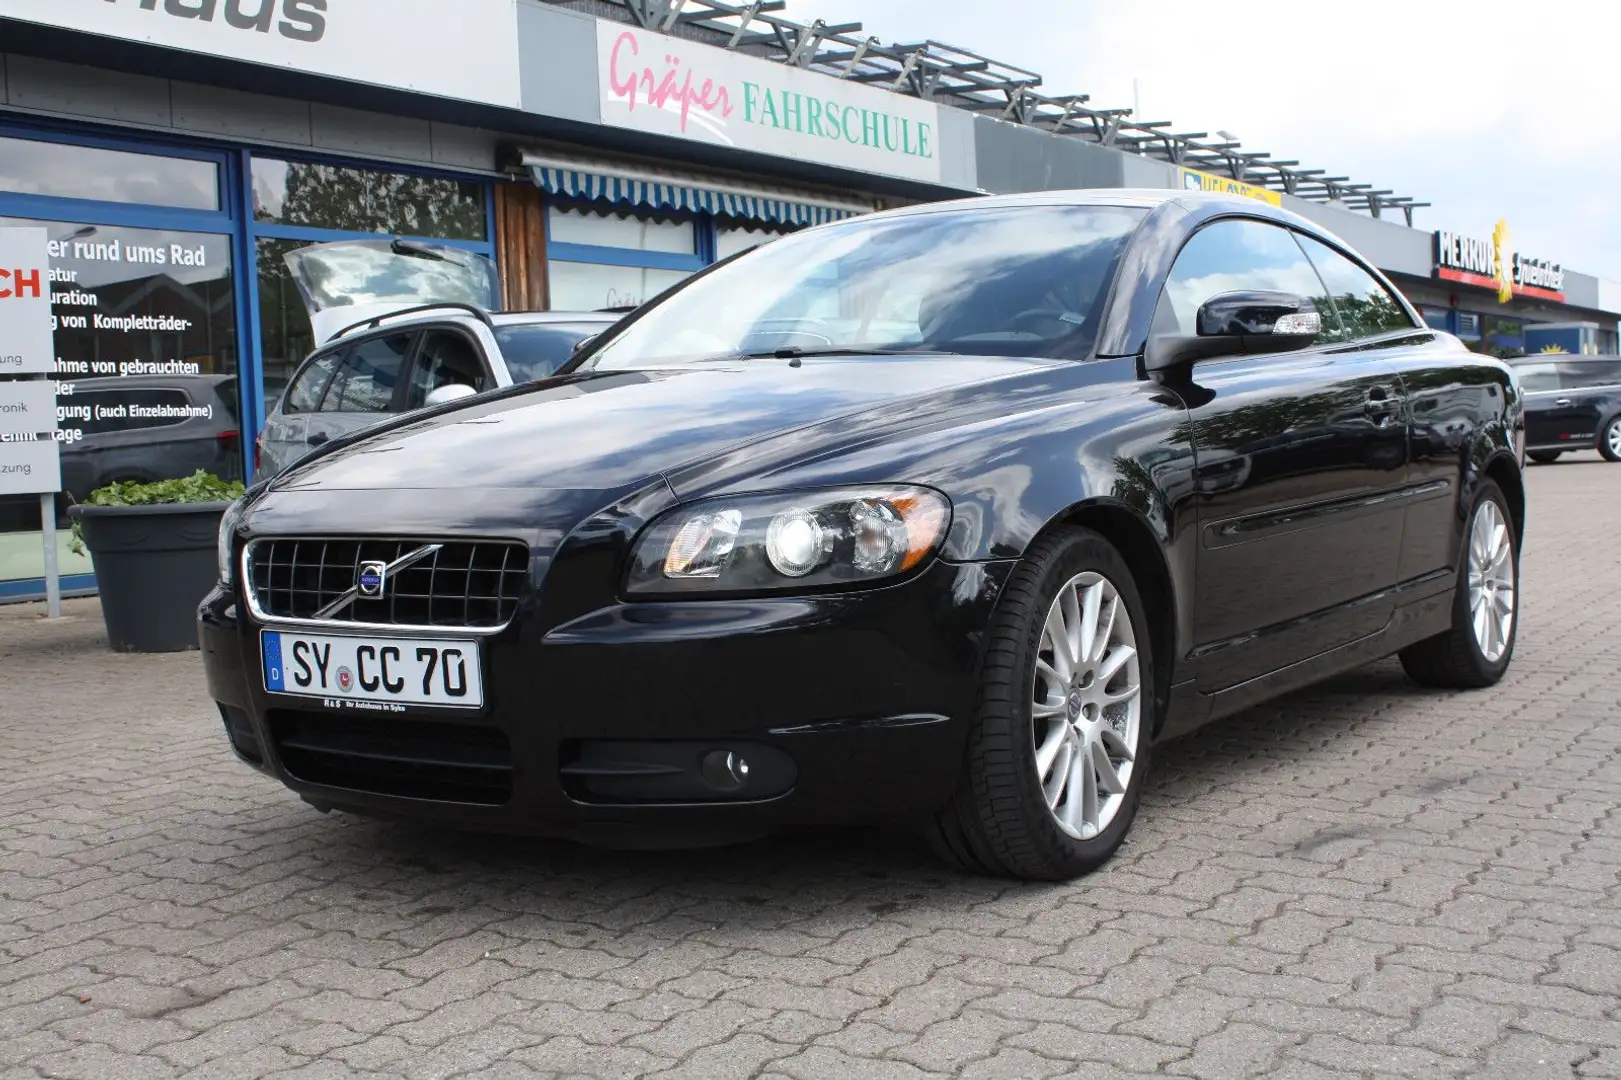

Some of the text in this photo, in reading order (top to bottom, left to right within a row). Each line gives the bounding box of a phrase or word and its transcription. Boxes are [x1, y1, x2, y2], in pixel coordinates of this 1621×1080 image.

[610, 31, 933, 158] Gräper FAHRSCHULE
[47, 239, 205, 267] er rund ums Rad
[1439, 232, 1495, 277] MERKUR
[61, 315, 87, 328] von
[93, 313, 192, 332] Kompletträder-
[91, 360, 116, 373] von
[119, 358, 200, 376] gebrauchten
[56, 404, 213, 421] gung (auch Einzelabnahme)
[271, 667, 279, 681] D
[292, 640, 468, 697] SY CC 70
